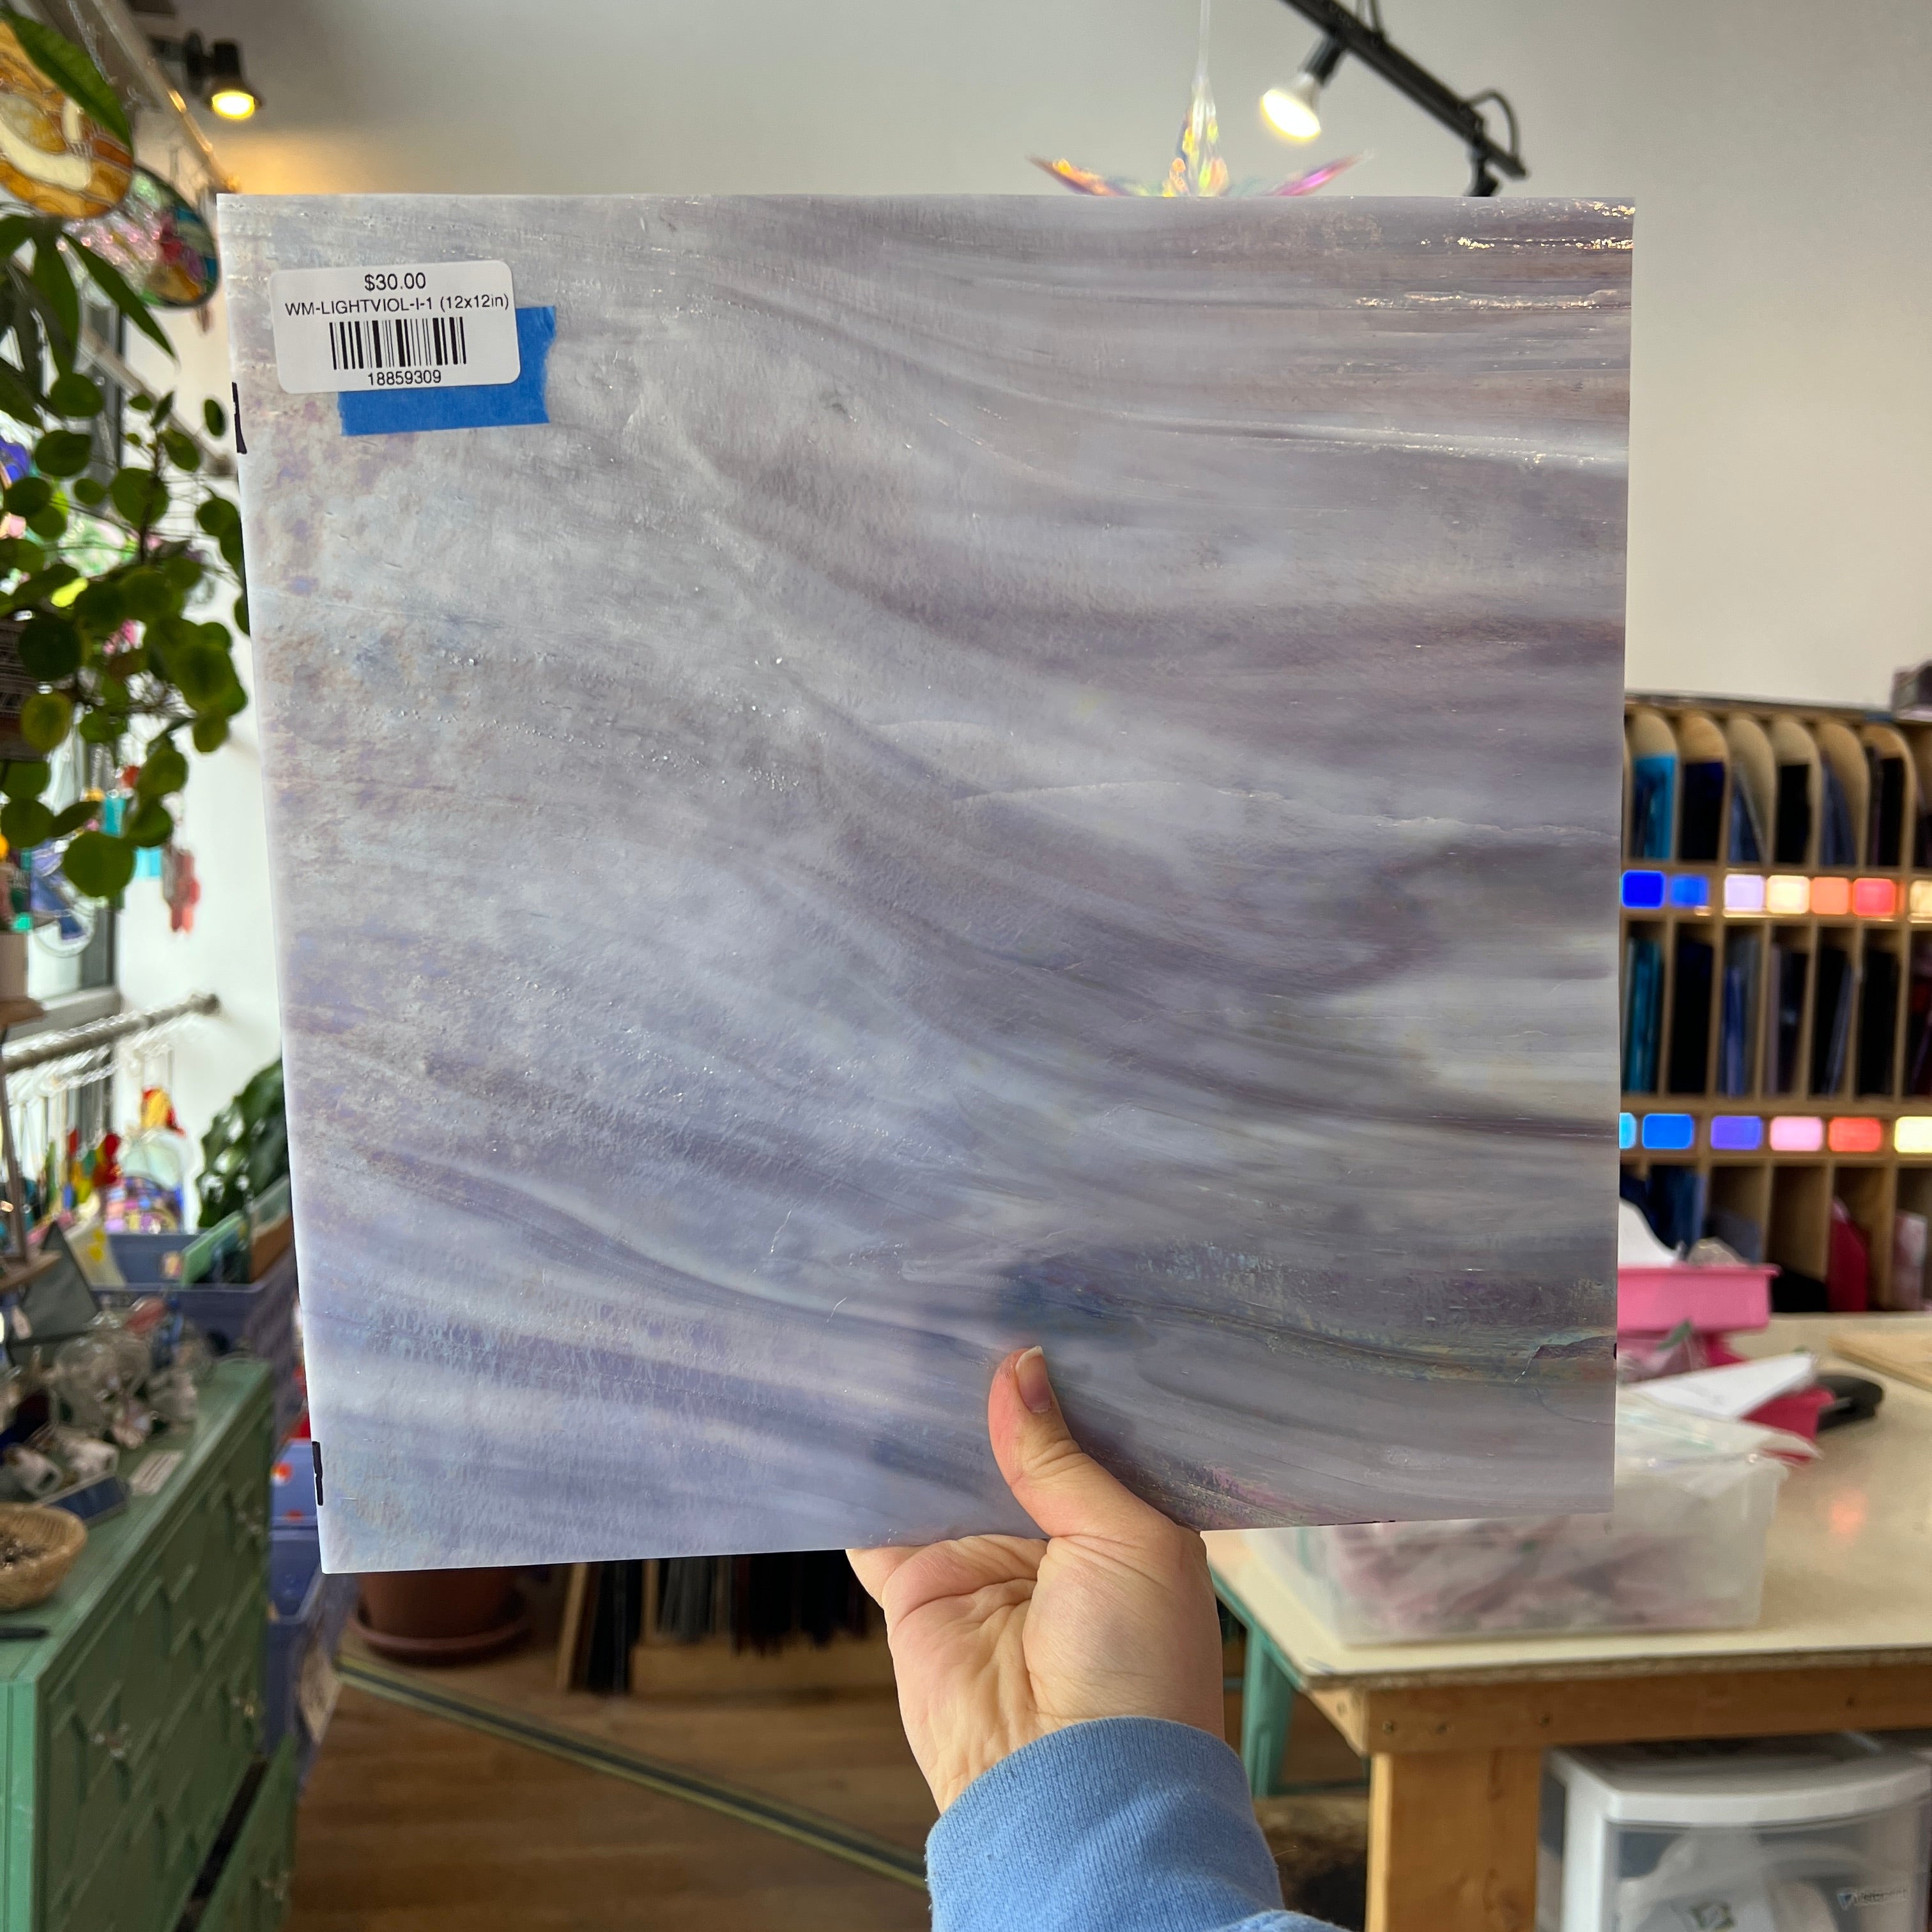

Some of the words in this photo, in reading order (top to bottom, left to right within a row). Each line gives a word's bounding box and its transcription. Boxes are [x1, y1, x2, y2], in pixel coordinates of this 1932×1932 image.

[364, 272, 426, 292] $30.00
[285, 296, 432, 316] WM-LIGHTVIOL-I-1
[440, 293, 509, 312] (12x12in)
[367, 369, 441, 385] 18859309
